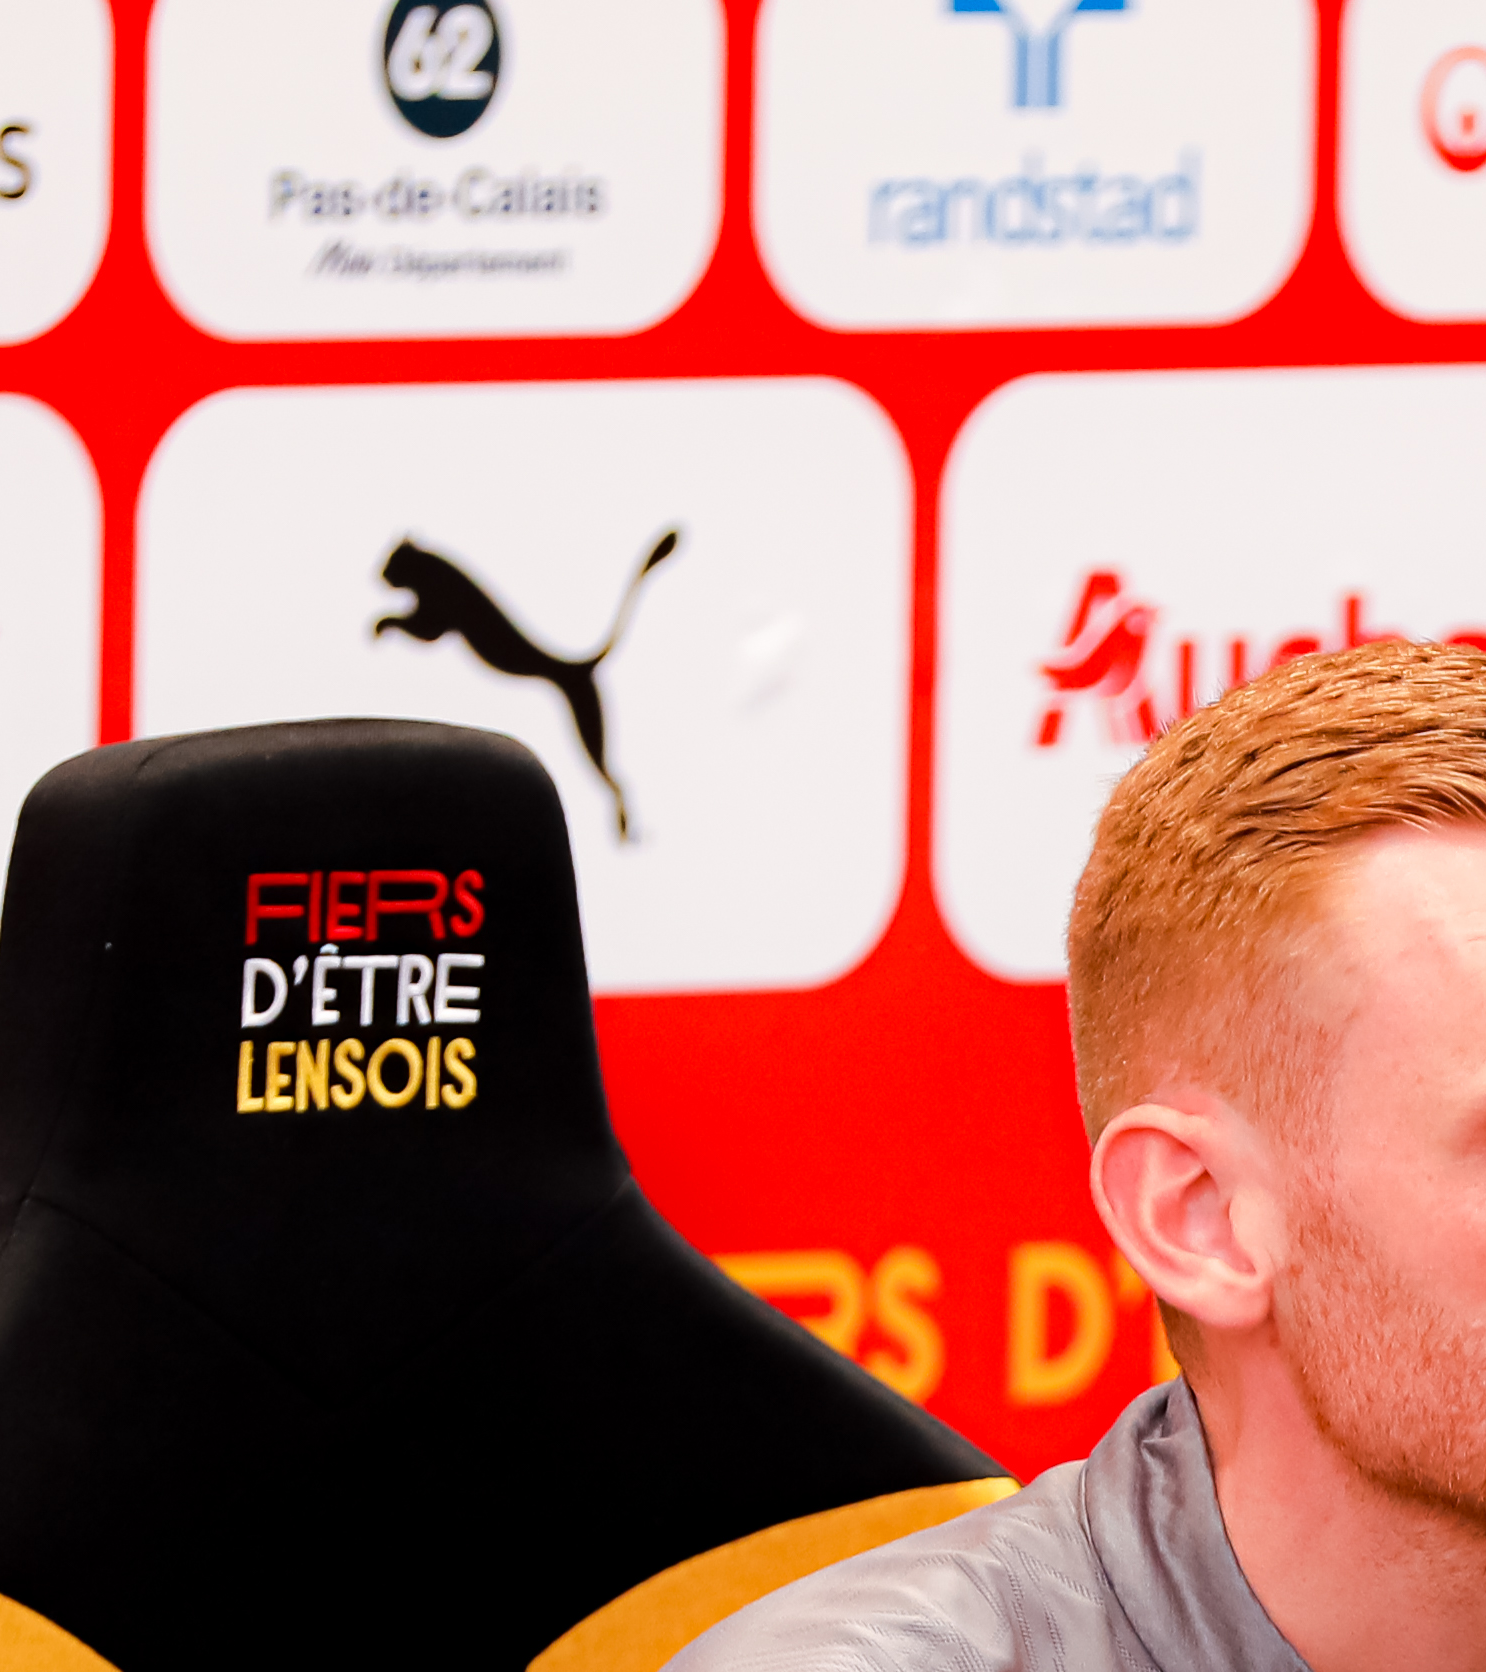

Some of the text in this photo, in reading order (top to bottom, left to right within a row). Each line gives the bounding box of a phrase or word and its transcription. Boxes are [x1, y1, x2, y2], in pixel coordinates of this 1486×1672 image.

[385, 4, 498, 101] 62
[269, 166, 605, 223] Pas-de-Calais
[868, 152, 1200, 250] randstad
[245, 869, 485, 945] FIERS
[241, 943, 485, 1028] D'ÊTRE
[236, 1036, 478, 1114] LENSOIS
